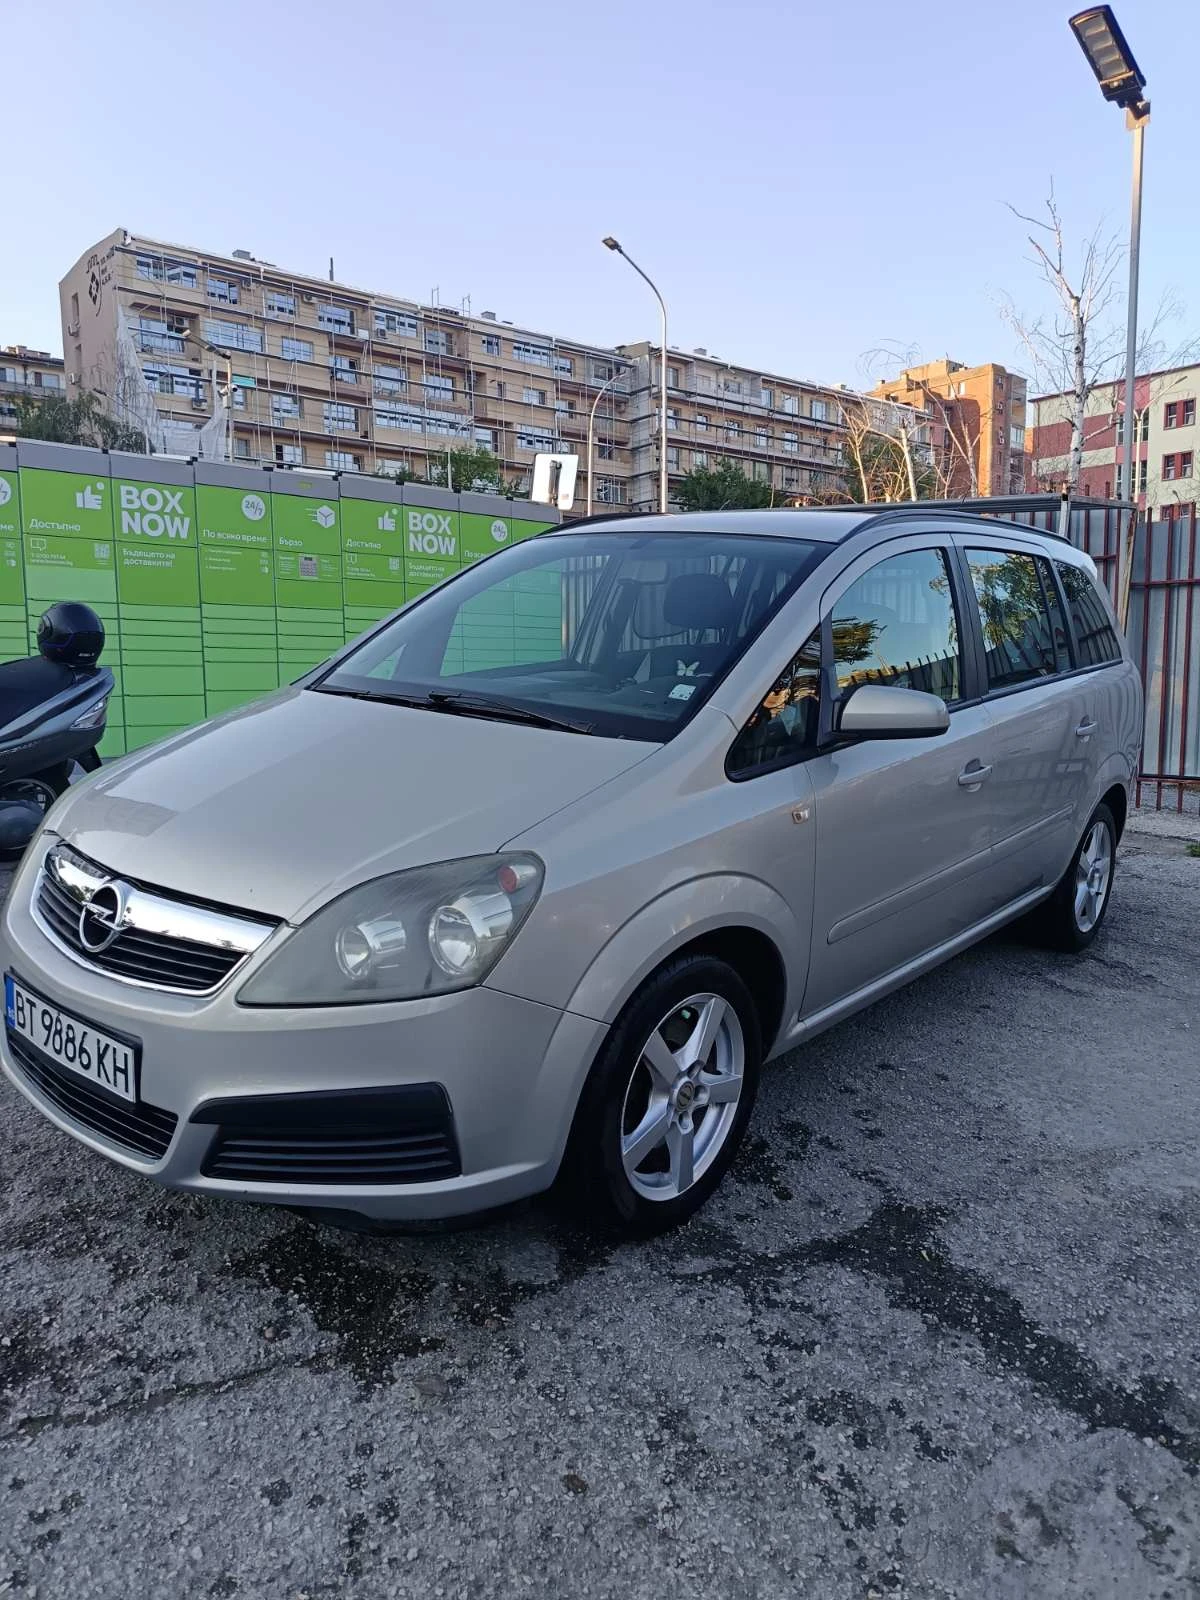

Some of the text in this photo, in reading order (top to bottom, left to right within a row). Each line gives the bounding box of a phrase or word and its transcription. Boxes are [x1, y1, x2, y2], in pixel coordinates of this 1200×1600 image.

[120, 484, 184, 515] BOX
[244, 500, 263, 517] 24/7
[30, 518, 81, 532] Достъпно
[121, 510, 191, 539] NOW
[203, 528, 215, 538] По
[408, 511, 452, 535] BOX
[279, 536, 303, 547] Бързо
[408, 532, 456, 556] NOW
[15, 990, 130, 1093] BT 9886 KH
